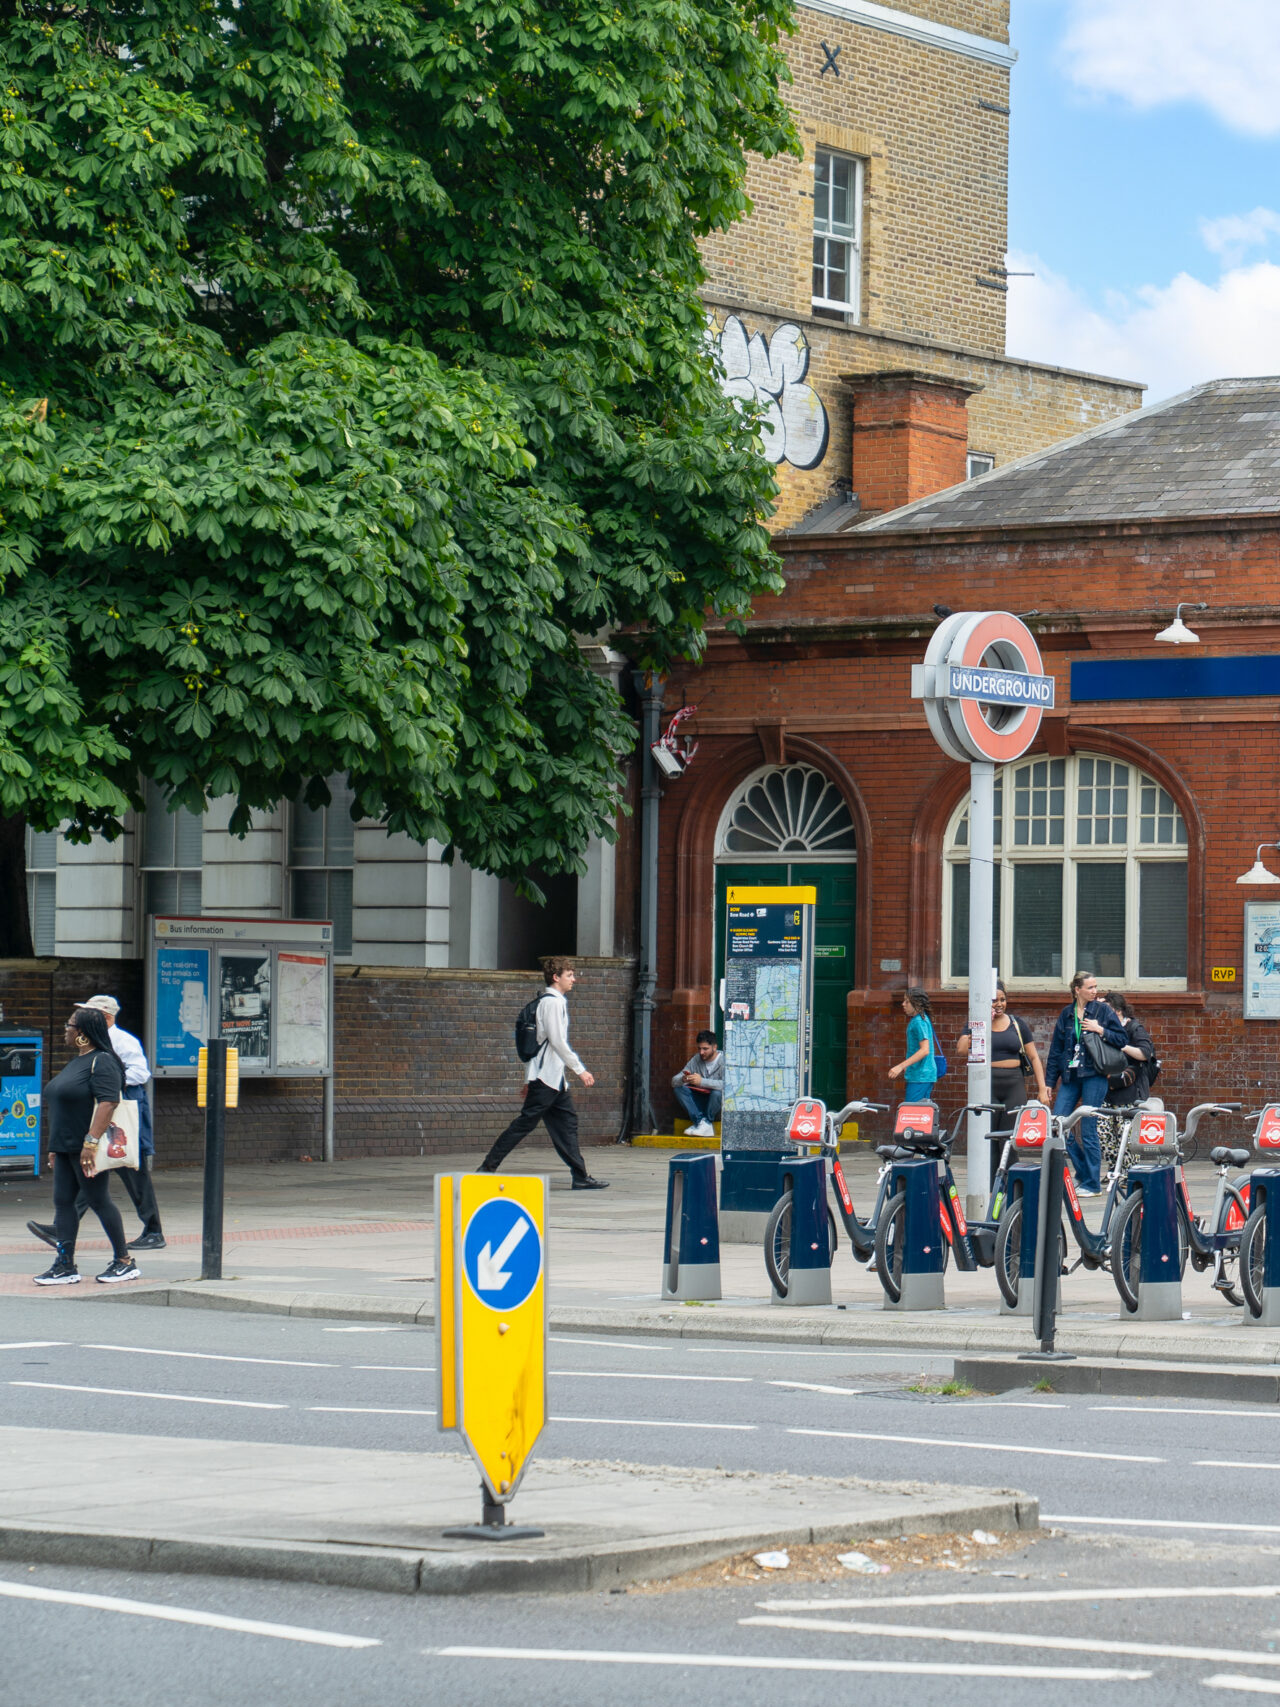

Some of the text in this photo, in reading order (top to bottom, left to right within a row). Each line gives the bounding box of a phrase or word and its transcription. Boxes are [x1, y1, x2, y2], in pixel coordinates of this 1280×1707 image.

[951, 673, 1051, 702] UNDERGROUND
[170, 925, 224, 934] Bus information
[1214, 970, 1234, 979] RVP
